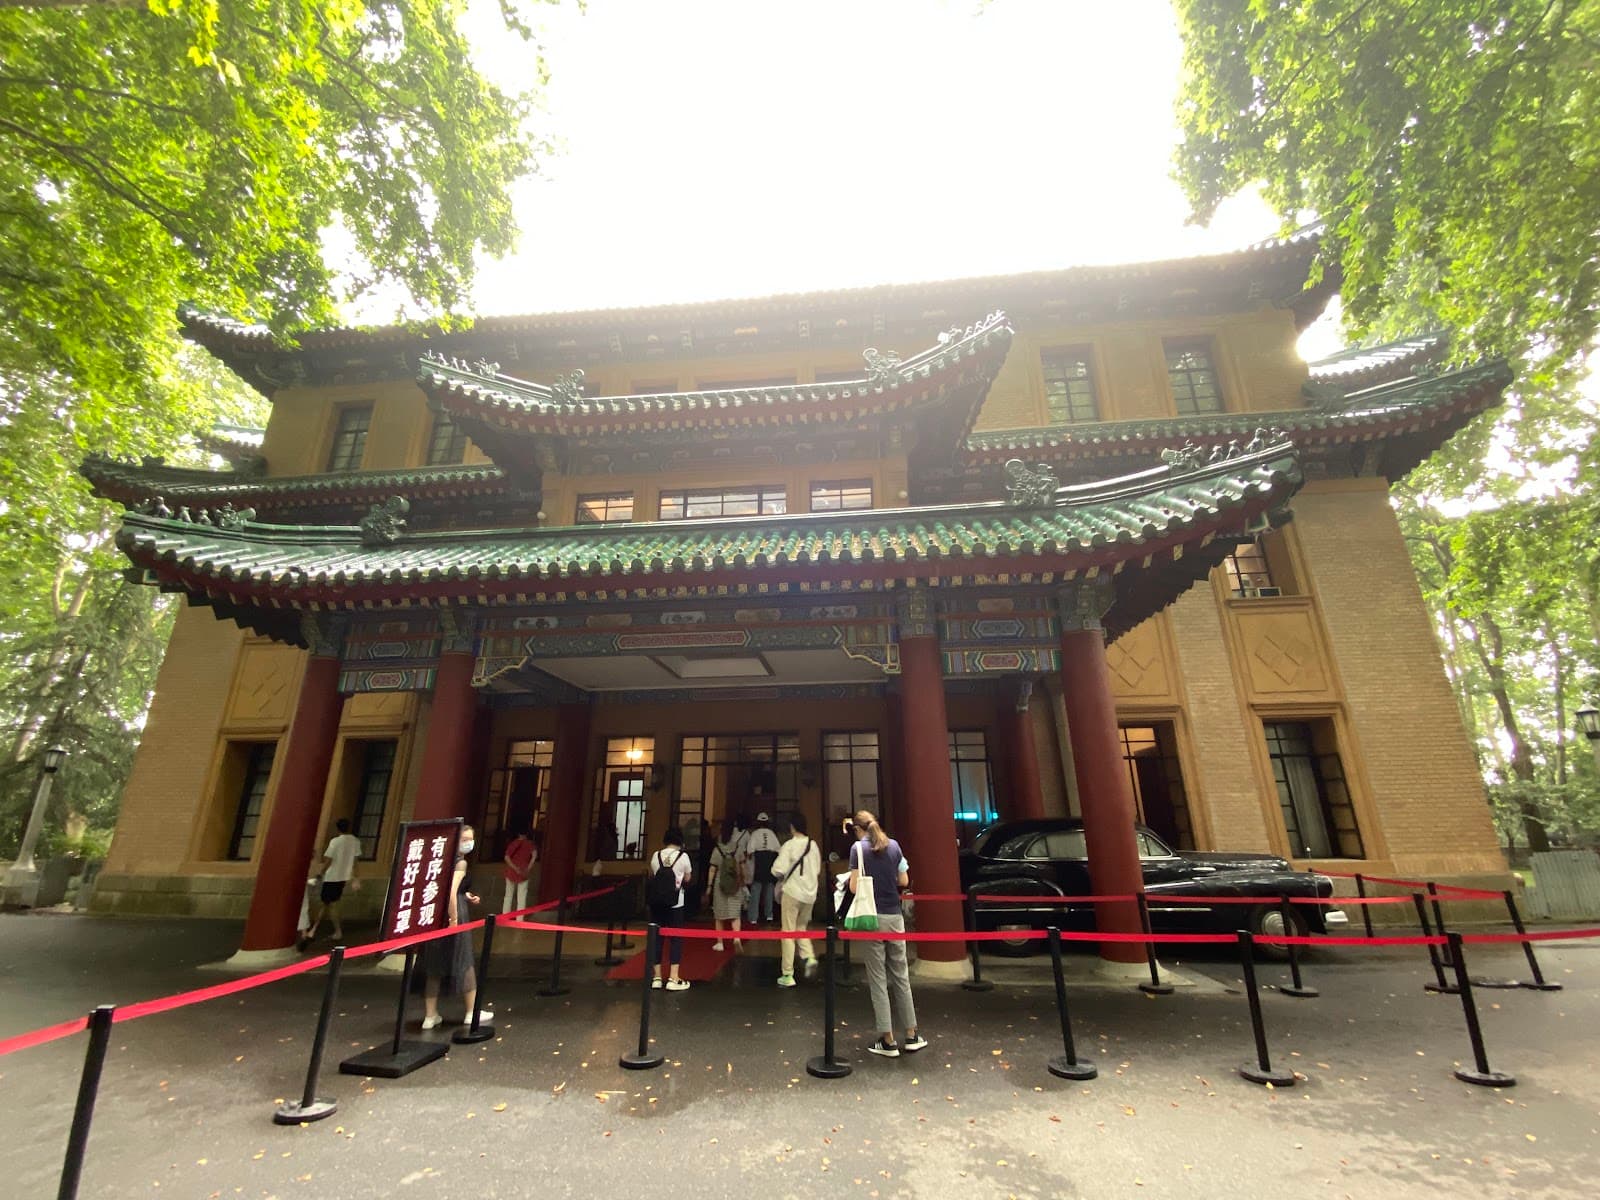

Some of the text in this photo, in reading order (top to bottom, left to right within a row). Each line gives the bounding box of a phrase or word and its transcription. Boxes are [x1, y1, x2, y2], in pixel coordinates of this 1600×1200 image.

[394, 839, 425, 934] 戴好口罩
[418, 836, 447, 927] 有序参观
